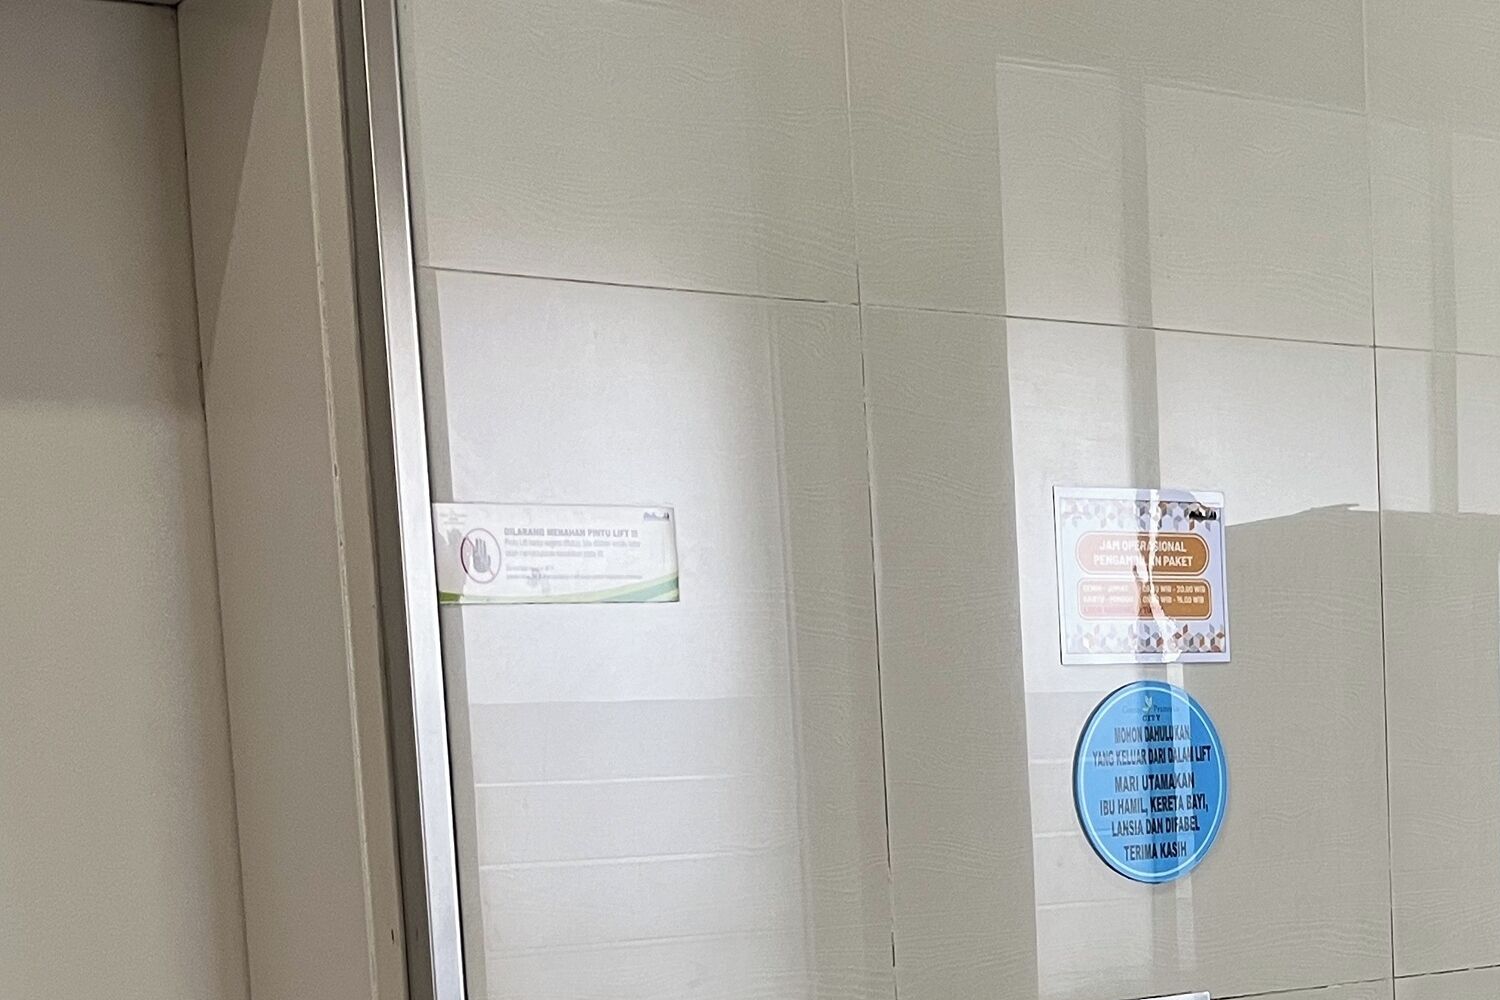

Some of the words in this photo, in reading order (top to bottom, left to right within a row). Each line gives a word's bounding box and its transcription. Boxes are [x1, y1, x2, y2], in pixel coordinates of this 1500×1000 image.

[504, 527, 545, 537] DILARANG
[587, 529, 611, 538] PINTU
[613, 530, 629, 538] LIFT
[1099, 541, 1121, 551] JAM
[1163, 555, 1193, 567] PAKET
[1142, 714, 1161, 722] CITY
[1114, 726, 1143, 744] MOHON
[1144, 724, 1191, 743] DAHULUKAN
[1093, 750, 1114, 767] YANG
[1116, 748, 1147, 766] KELUAR
[1148, 747, 1166, 765] DARI
[1167, 746, 1194, 764] DALAM
[1195, 745, 1211, 762] LIFT
[1114, 776, 1139, 793] MARI
[1141, 772, 1195, 790] UTAMAKAN
[1100, 799, 1115, 816] IBU
[1118, 797, 1149, 817] HAMIL,
[1150, 795, 1184, 813] KERETA
[1186, 793, 1209, 812] BAYI,
[1111, 820, 1144, 837] LANSIA
[1146, 818, 1163, 835] DAN
[1165, 816, 1200, 833] DIFABEL
[1124, 843, 1158, 861] TERIMA
[1160, 841, 1187, 858] KASIH
